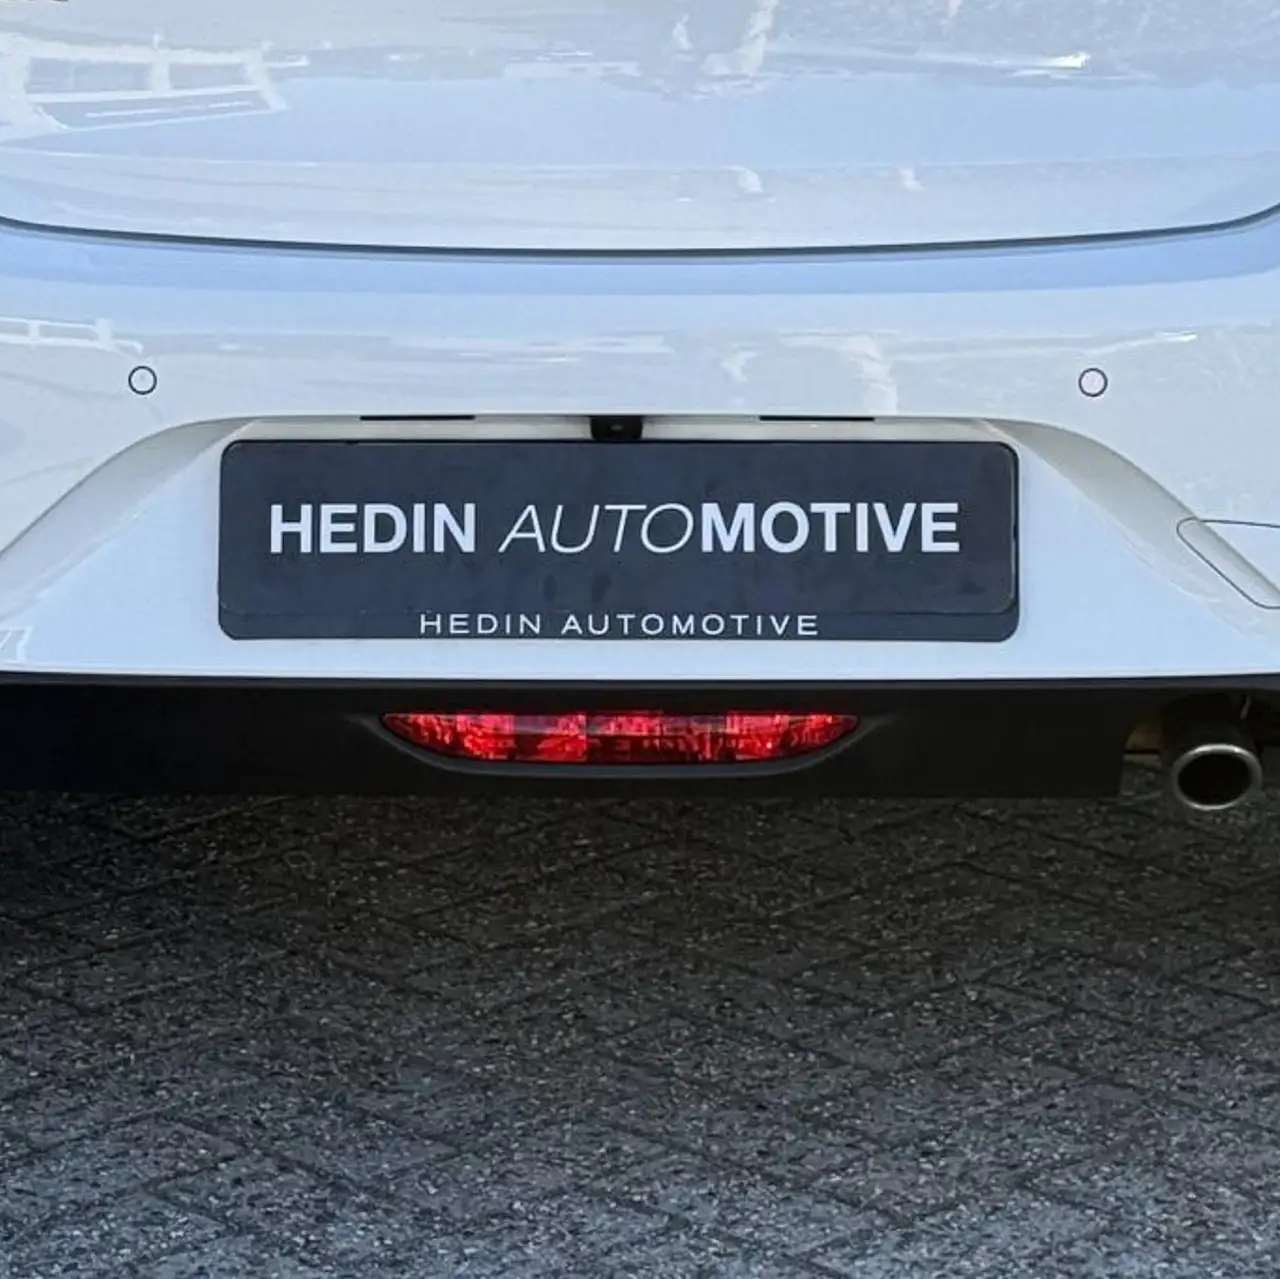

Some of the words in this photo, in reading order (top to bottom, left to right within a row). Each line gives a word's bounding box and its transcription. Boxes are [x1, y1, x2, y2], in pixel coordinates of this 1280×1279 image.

[269, 502, 477, 554] HEDIN
[498, 501, 961, 554] AUTOMOTIVE
[419, 612, 542, 635] HEDIN
[560, 613, 819, 637] AUTOMOTIVE
